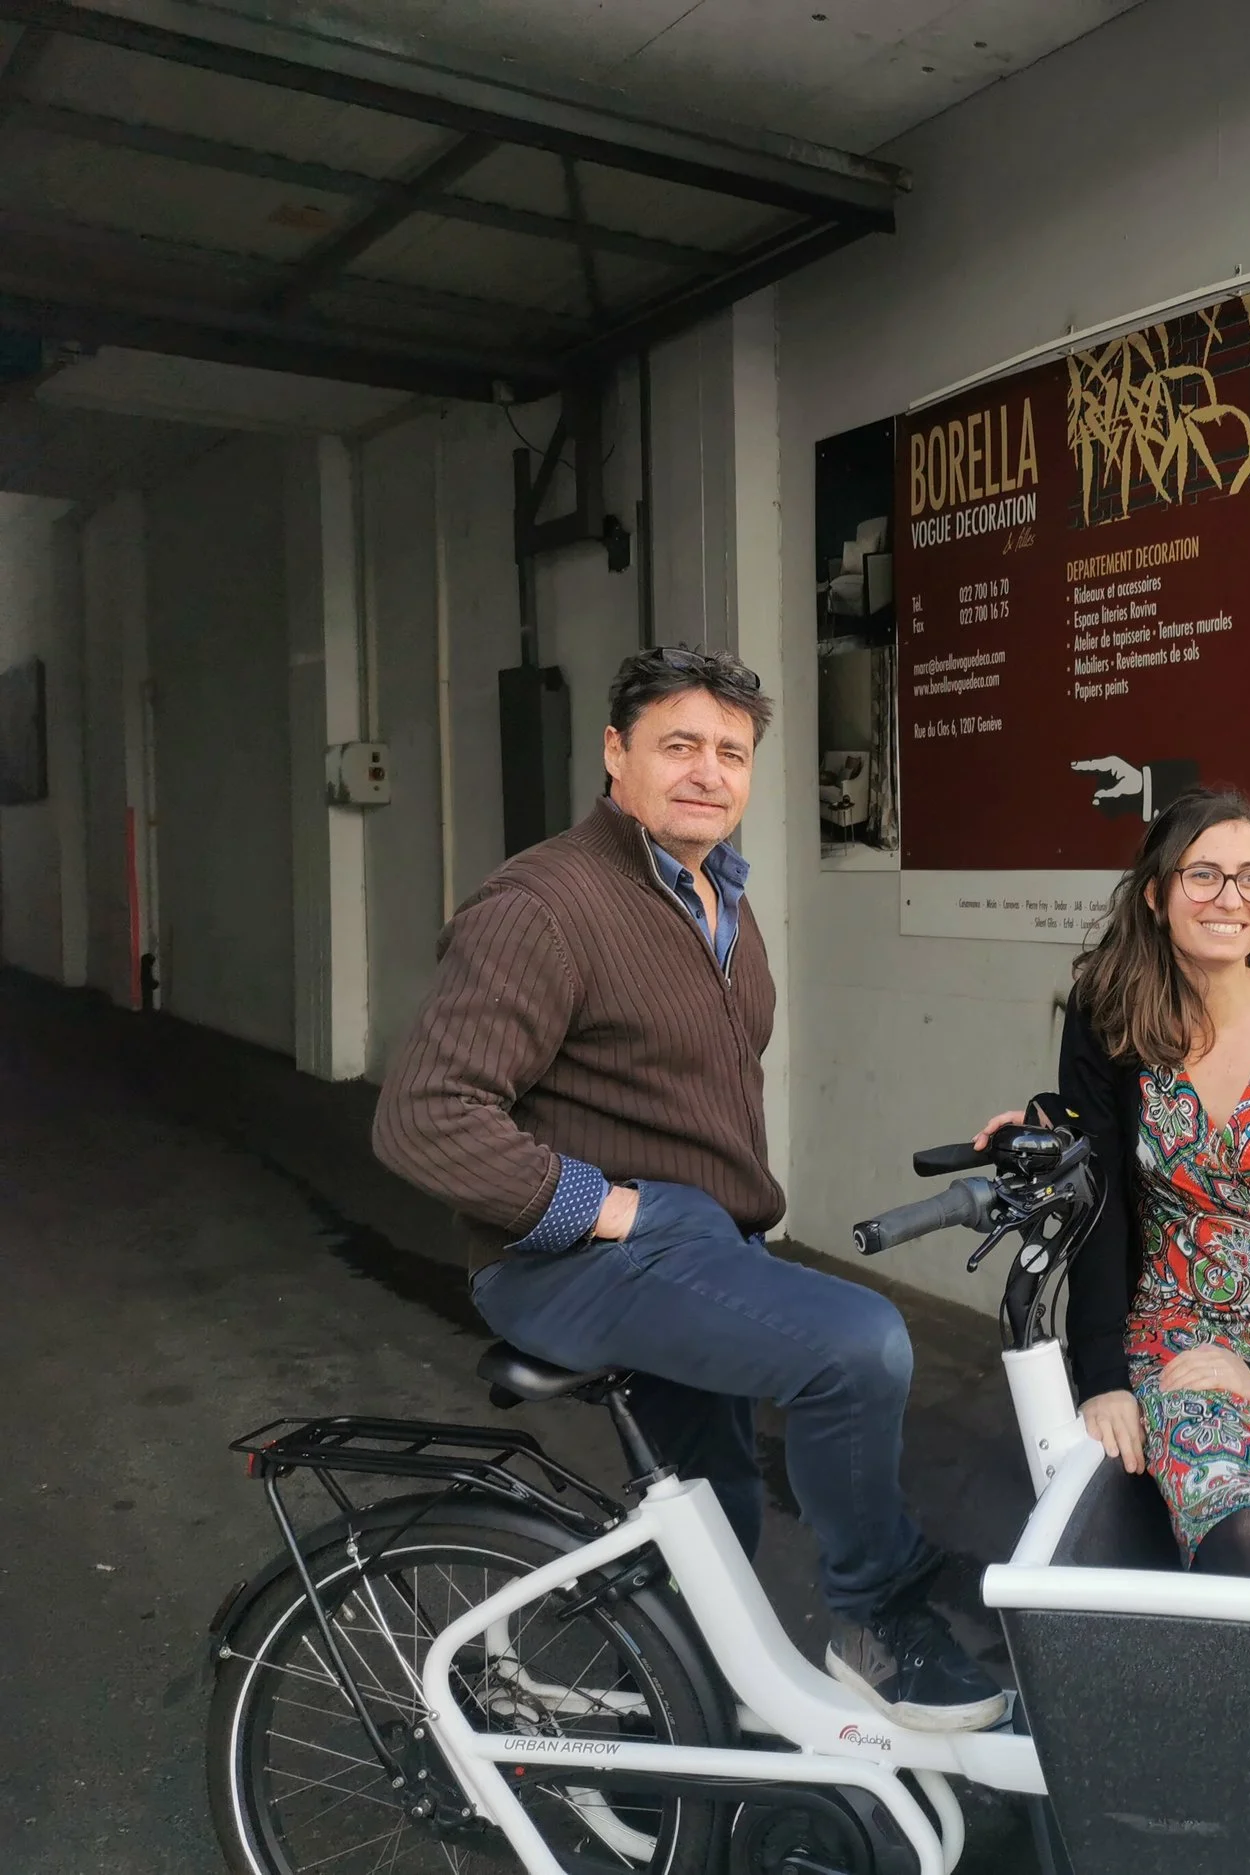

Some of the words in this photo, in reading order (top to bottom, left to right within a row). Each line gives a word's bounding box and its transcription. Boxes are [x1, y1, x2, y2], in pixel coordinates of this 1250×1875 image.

[910, 397, 1039, 516] BORELLA
[912, 513, 952, 549] VOGUE
[956, 492, 1037, 540] DECORATION
[1067, 549, 1133, 583] DEPARTEMENT
[1135, 536, 1200, 569] DECORATION
[959, 585, 973, 603] 022
[974, 582, 988, 600] 700
[990, 580, 998, 598] 16
[1000, 578, 1009, 595] 70
[1074, 584, 1105, 605] Rideaux
[1107, 582, 1116, 598] et
[1117, 575, 1162, 597] accessoires
[912, 618, 925, 634] Fax
[960, 607, 973, 625] 022
[974, 604, 988, 622] 700
[990, 602, 998, 620] 16
[1000, 600, 1009, 618] 75
[1074, 610, 1100, 632] Espace
[1101, 604, 1128, 625] literies
[1130, 600, 1157, 618] Roviva
[1074, 631, 1098, 652] Atelier
[1101, 629, 1111, 648] de
[1112, 625, 1150, 650] tapisserie
[1158, 620, 1194, 640] Tentures
[1196, 610, 1232, 634] murales
[913, 648, 1006, 676] marc@borellavoguedeco.com
[1074, 654, 1110, 676] Mobiliers
[1116, 648, 1168, 671] Revêtements
[1170, 643, 1181, 663] de
[1183, 639, 1200, 660] sols
[913, 671, 1000, 697] www.borellavoguedeco.com
[1074, 682, 1103, 702] Papiers
[1105, 678, 1129, 700] peints
[914, 723, 926, 739] Rue
[927, 720, 936, 737] du
[937, 719, 950, 736] Clos
[951, 719, 958, 738] 6,
[960, 717, 976, 734] 1207
[977, 715, 1002, 732] Genève
[504, 1738, 559, 1752] URBAN
[560, 1742, 621, 1755] ARROW
